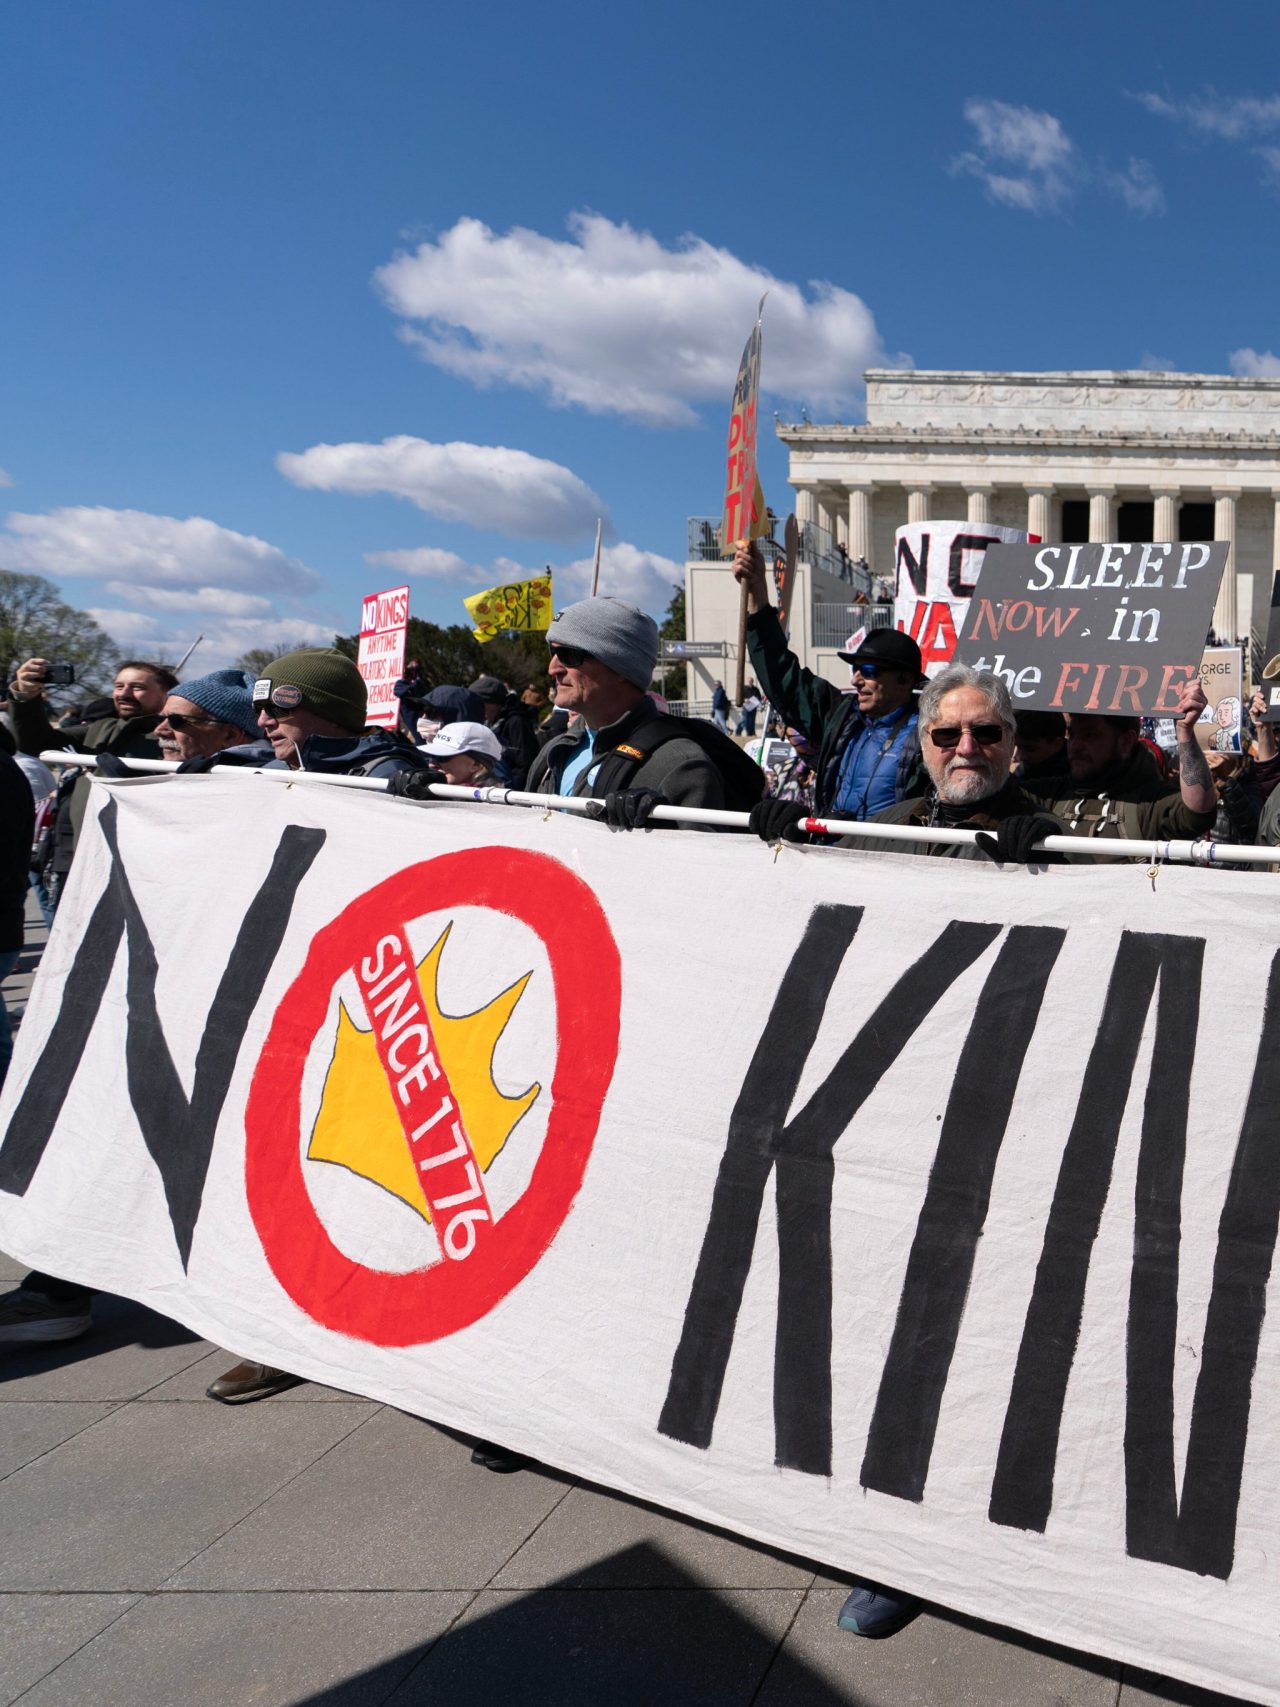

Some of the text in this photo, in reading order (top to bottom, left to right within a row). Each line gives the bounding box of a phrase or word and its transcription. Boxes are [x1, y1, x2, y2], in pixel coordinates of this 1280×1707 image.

[1026, 542, 1211, 591] SLEEP
[361, 594, 407, 632] NO KINGS
[1107, 596, 1161, 642] in
[366, 633, 398, 655] ANYTIME
[1049, 661, 1196, 712] FIRE
[1199, 662, 1232, 675] ORGE
[361, 934, 490, 1262] SINCE 1776
